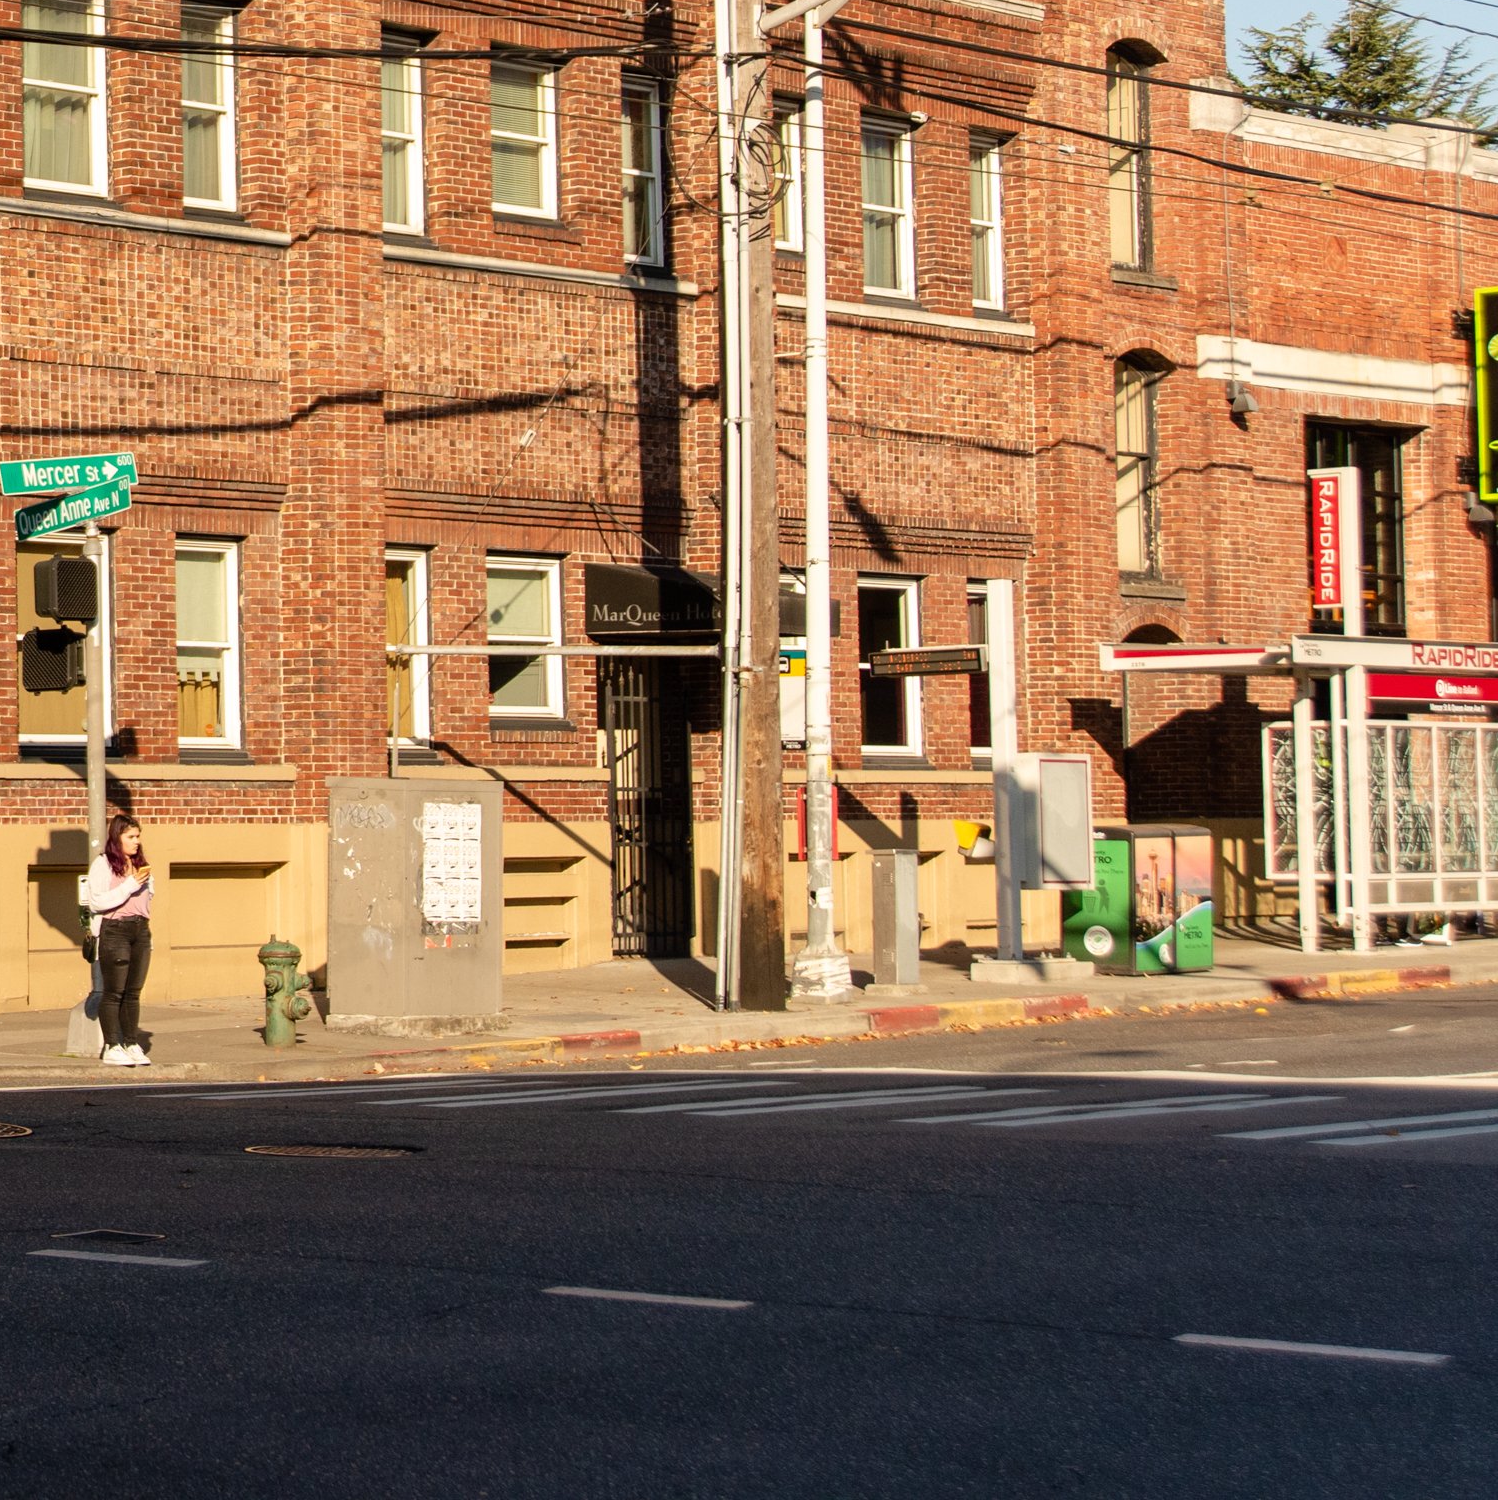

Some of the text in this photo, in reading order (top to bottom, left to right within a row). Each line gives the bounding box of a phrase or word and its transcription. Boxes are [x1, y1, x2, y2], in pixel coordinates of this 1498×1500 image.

[21, 455, 132, 487] Mercer St 600
[118, 478, 128, 491] 00
[18, 491, 120, 535] Queen Anne Ave N
[1319, 481, 1334, 600] RAPIDRIDE
[592, 604, 722, 626] MarQueen Hot
[1093, 855, 1112, 864] TRO
